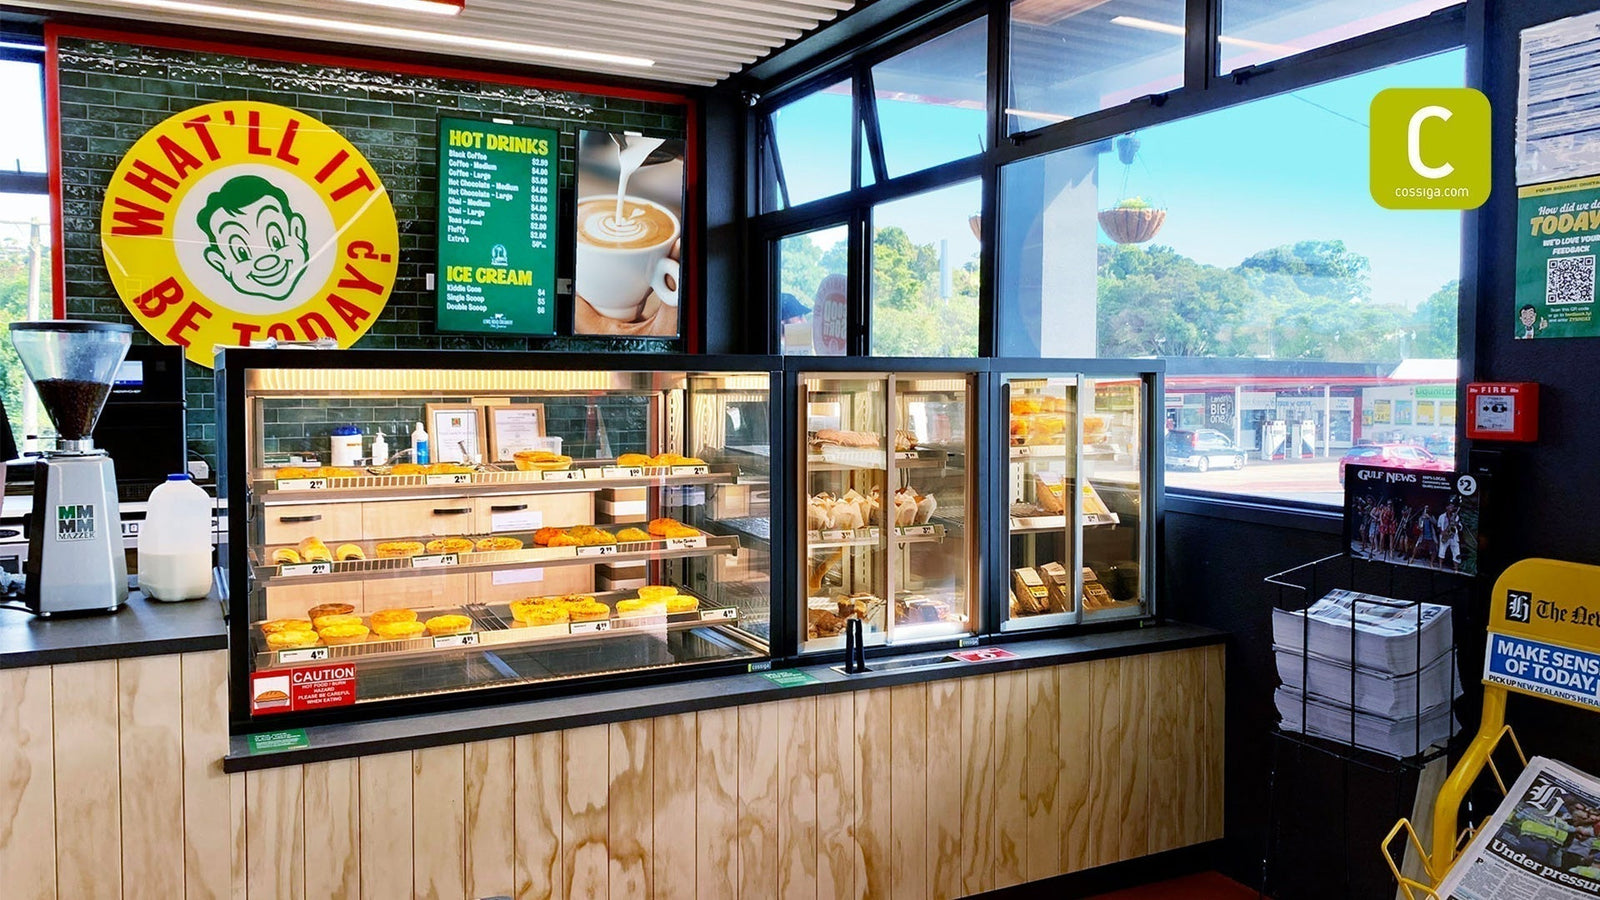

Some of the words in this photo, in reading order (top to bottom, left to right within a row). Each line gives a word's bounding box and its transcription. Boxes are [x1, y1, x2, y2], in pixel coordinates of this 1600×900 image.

[450, 130, 484, 148] HOT
[487, 134, 548, 155] DRINKS
[449, 149, 466, 158] Black
[467, 151, 487, 160] Coffee
[448, 159, 469, 168] Coffee
[474, 162, 497, 171] Medium
[111, 110, 300, 236] WHAT'LL
[314, 149, 375, 202] IT
[448, 168, 469, 177] Coffee
[474, 170, 491, 180] Large
[460, 179, 490, 189] Chocolate
[496, 182, 519, 191] Medium
[460, 188, 490, 198] Chocolate
[496, 192, 513, 201] Large
[467, 199, 490, 207] Medium
[1538, 206, 1558, 215] How
[1560, 202, 1575, 212] did
[467, 208, 485, 217] Large
[448, 225, 466, 234] Fluffy
[1552, 245, 1590, 254] FEEDBACK
[447, 266, 472, 282] ICE
[475, 268, 532, 286] CREAM
[447, 284, 466, 292] Kiddie
[447, 294, 465, 302] Single
[466, 294, 484, 303] Scoop
[133, 276, 212, 348] BE
[447, 302, 467, 311] Double
[469, 303, 487, 312] Scoop
[1211, 404, 1225, 415] BIG
[1211, 415, 1225, 423] one
[1358, 470, 1384, 480] GULF
[1386, 472, 1417, 483] NEWS
[1460, 480, 1472, 492] $2
[1536, 600, 1568, 623] The
[1497, 640, 1550, 664] MAKE
[1552, 652, 1600, 675] SENS
[293, 667, 354, 683] CAUTION
[1505, 659, 1529, 675] OF
[1532, 664, 1596, 692] TODAY.
[1488, 674, 1505, 684] PICK
[1506, 678, 1516, 686] UP
[1517, 680, 1534, 691] NEW
[1535, 684, 1576, 701] ZEALAND'S
[1577, 695, 1600, 706] HERA
[1492, 839, 1543, 870] Under
